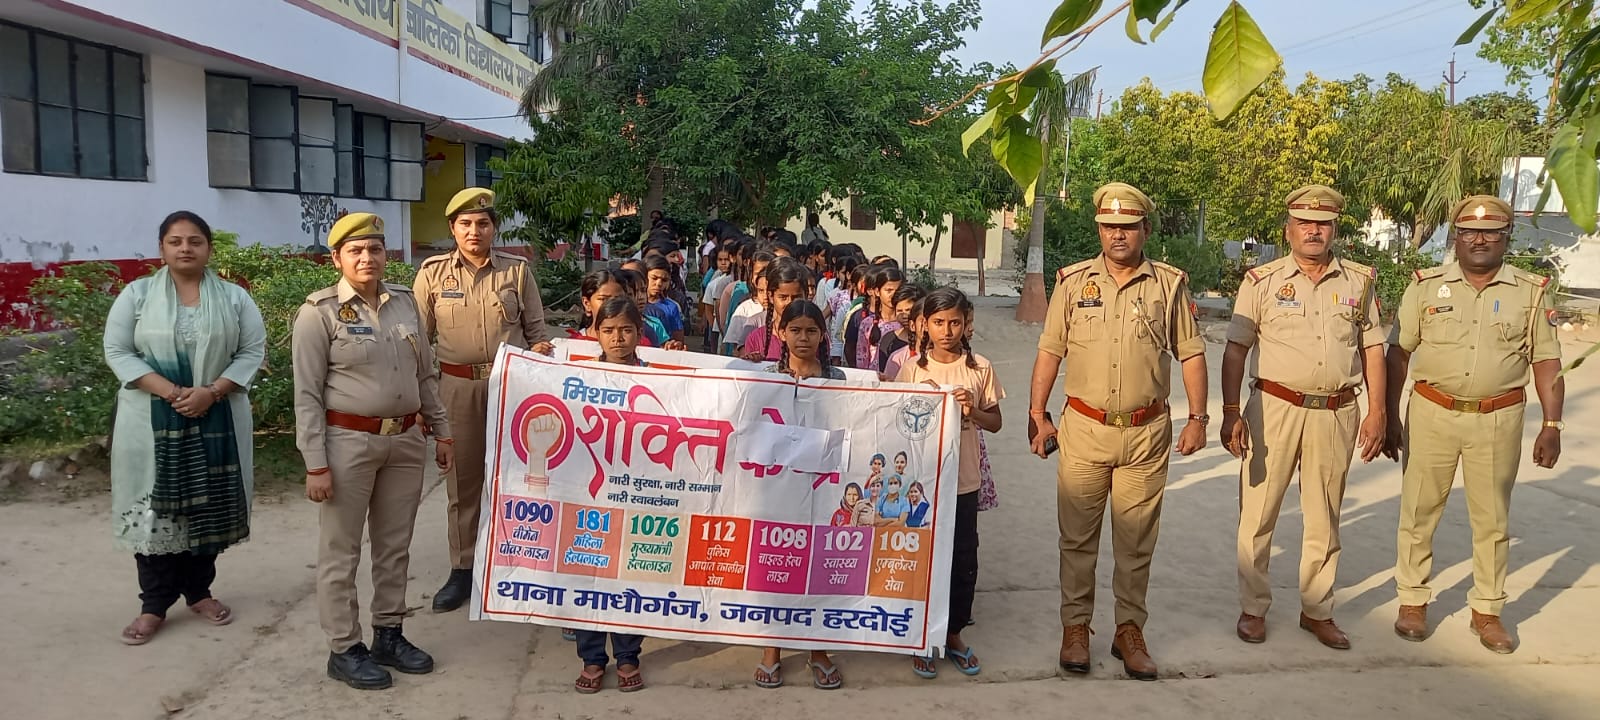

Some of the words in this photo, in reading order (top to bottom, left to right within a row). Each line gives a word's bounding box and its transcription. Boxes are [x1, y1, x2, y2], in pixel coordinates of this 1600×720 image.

[406, 0, 461, 59] बालिका
[464, 22, 514, 87] विद्यालय
[562, 376, 627, 407] मिशन
[576, 385, 734, 500] शक्ति
[608, 474, 630, 486] नारी
[664, 479, 686, 492] नारी
[688, 482, 722, 494] सम्मान
[607, 490, 628, 503] नारी
[630, 494, 679, 508] स्वावलंबन
[505, 500, 553, 524] 1090
[576, 509, 610, 533] 181
[630, 514, 679, 538] 1076
[701, 521, 736, 542] 112
[573, 533, 604, 550] महिला
[759, 525, 808, 549] 1098
[823, 530, 864, 551] 102
[879, 530, 919, 553] 108
[524, 547, 550, 560] लाइन
[564, 548, 609, 567] हेल्पलाइन
[631, 541, 673, 558] मुख्यमंत्री
[706, 544, 730, 560] पुलिस
[627, 556, 673, 573] हेल्पलाइन
[689, 560, 716, 572] आपात
[716, 561, 745, 574] कालीन
[758, 553, 784, 567] चाइल्ड
[823, 558, 859, 569] स्वास्थ्य
[707, 573, 724, 586] सेवा
[766, 570, 789, 583] लाइन
[828, 570, 849, 585] सेवा
[884, 576, 904, 592] सेवा
[497, 580, 566, 606] थाना
[574, 588, 709, 622] माधौगंज,
[720, 602, 816, 627] जनपद
[823, 605, 913, 637] हरदोई
